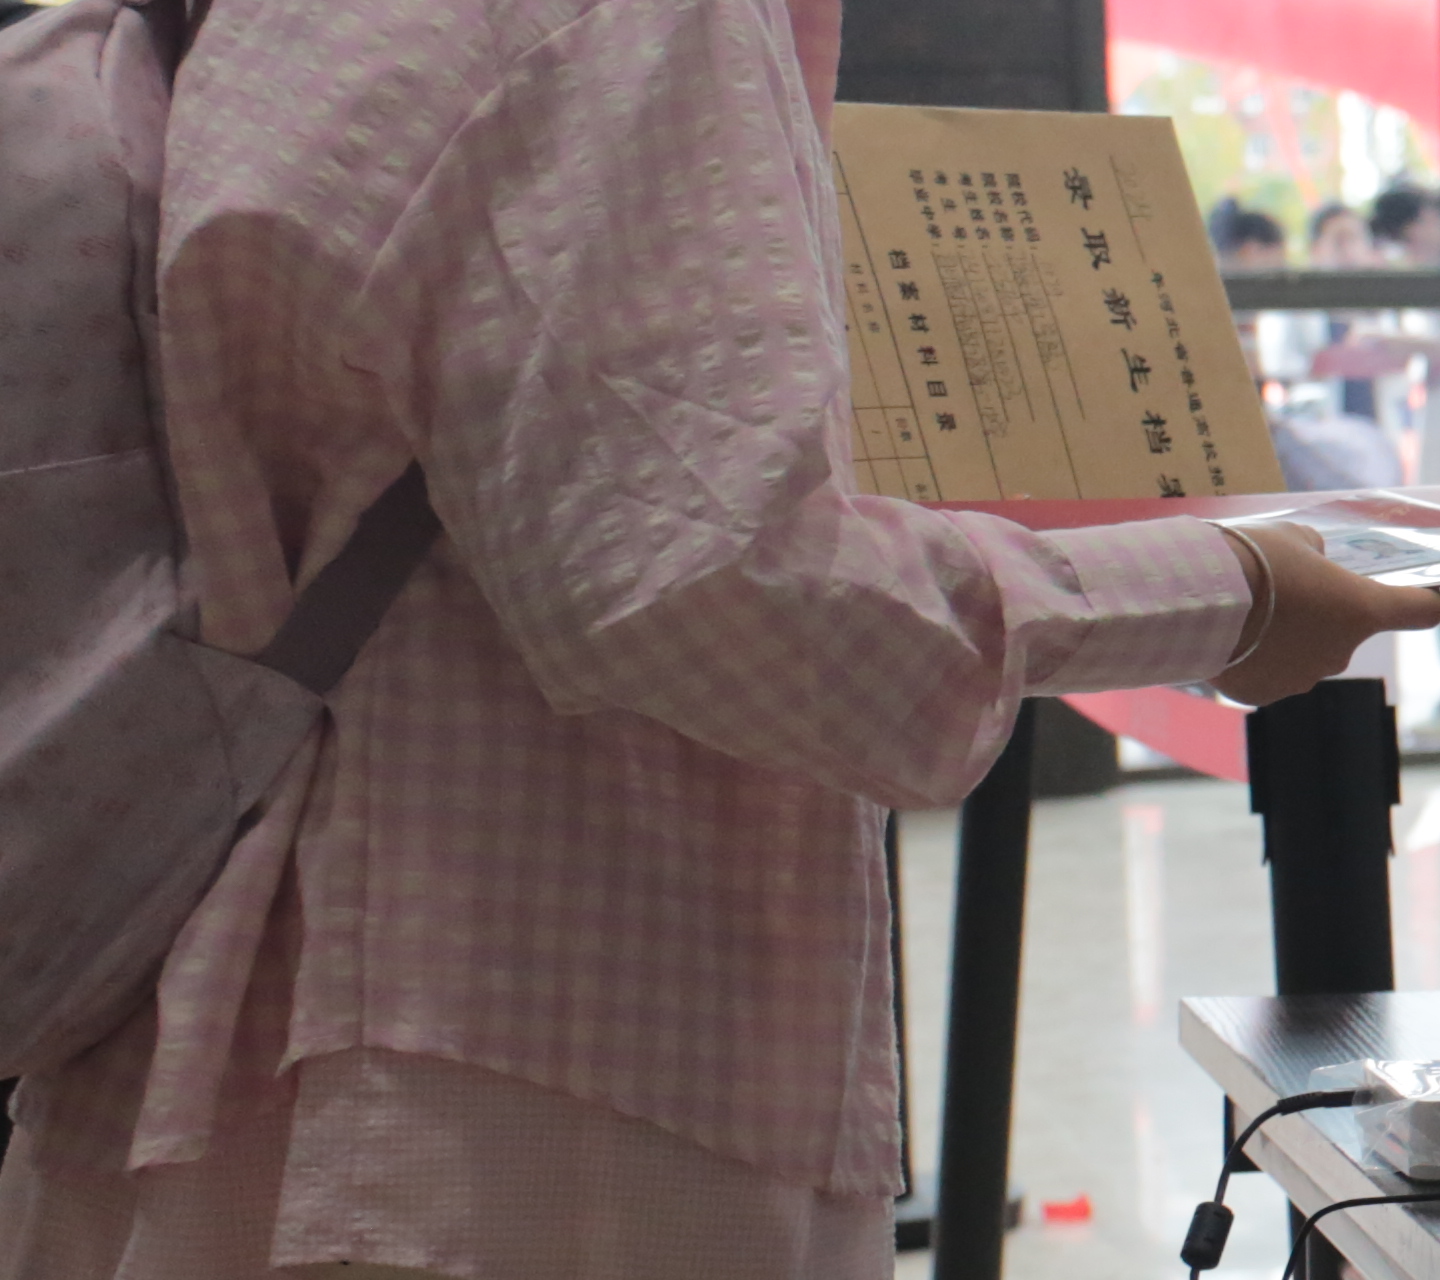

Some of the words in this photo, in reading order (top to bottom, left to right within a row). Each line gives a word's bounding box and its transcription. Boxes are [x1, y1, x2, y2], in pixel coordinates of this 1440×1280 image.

[887, 248, 957, 433] 档案材料目录
[1150, 270, 1227, 497] 年河北省普通高校招
